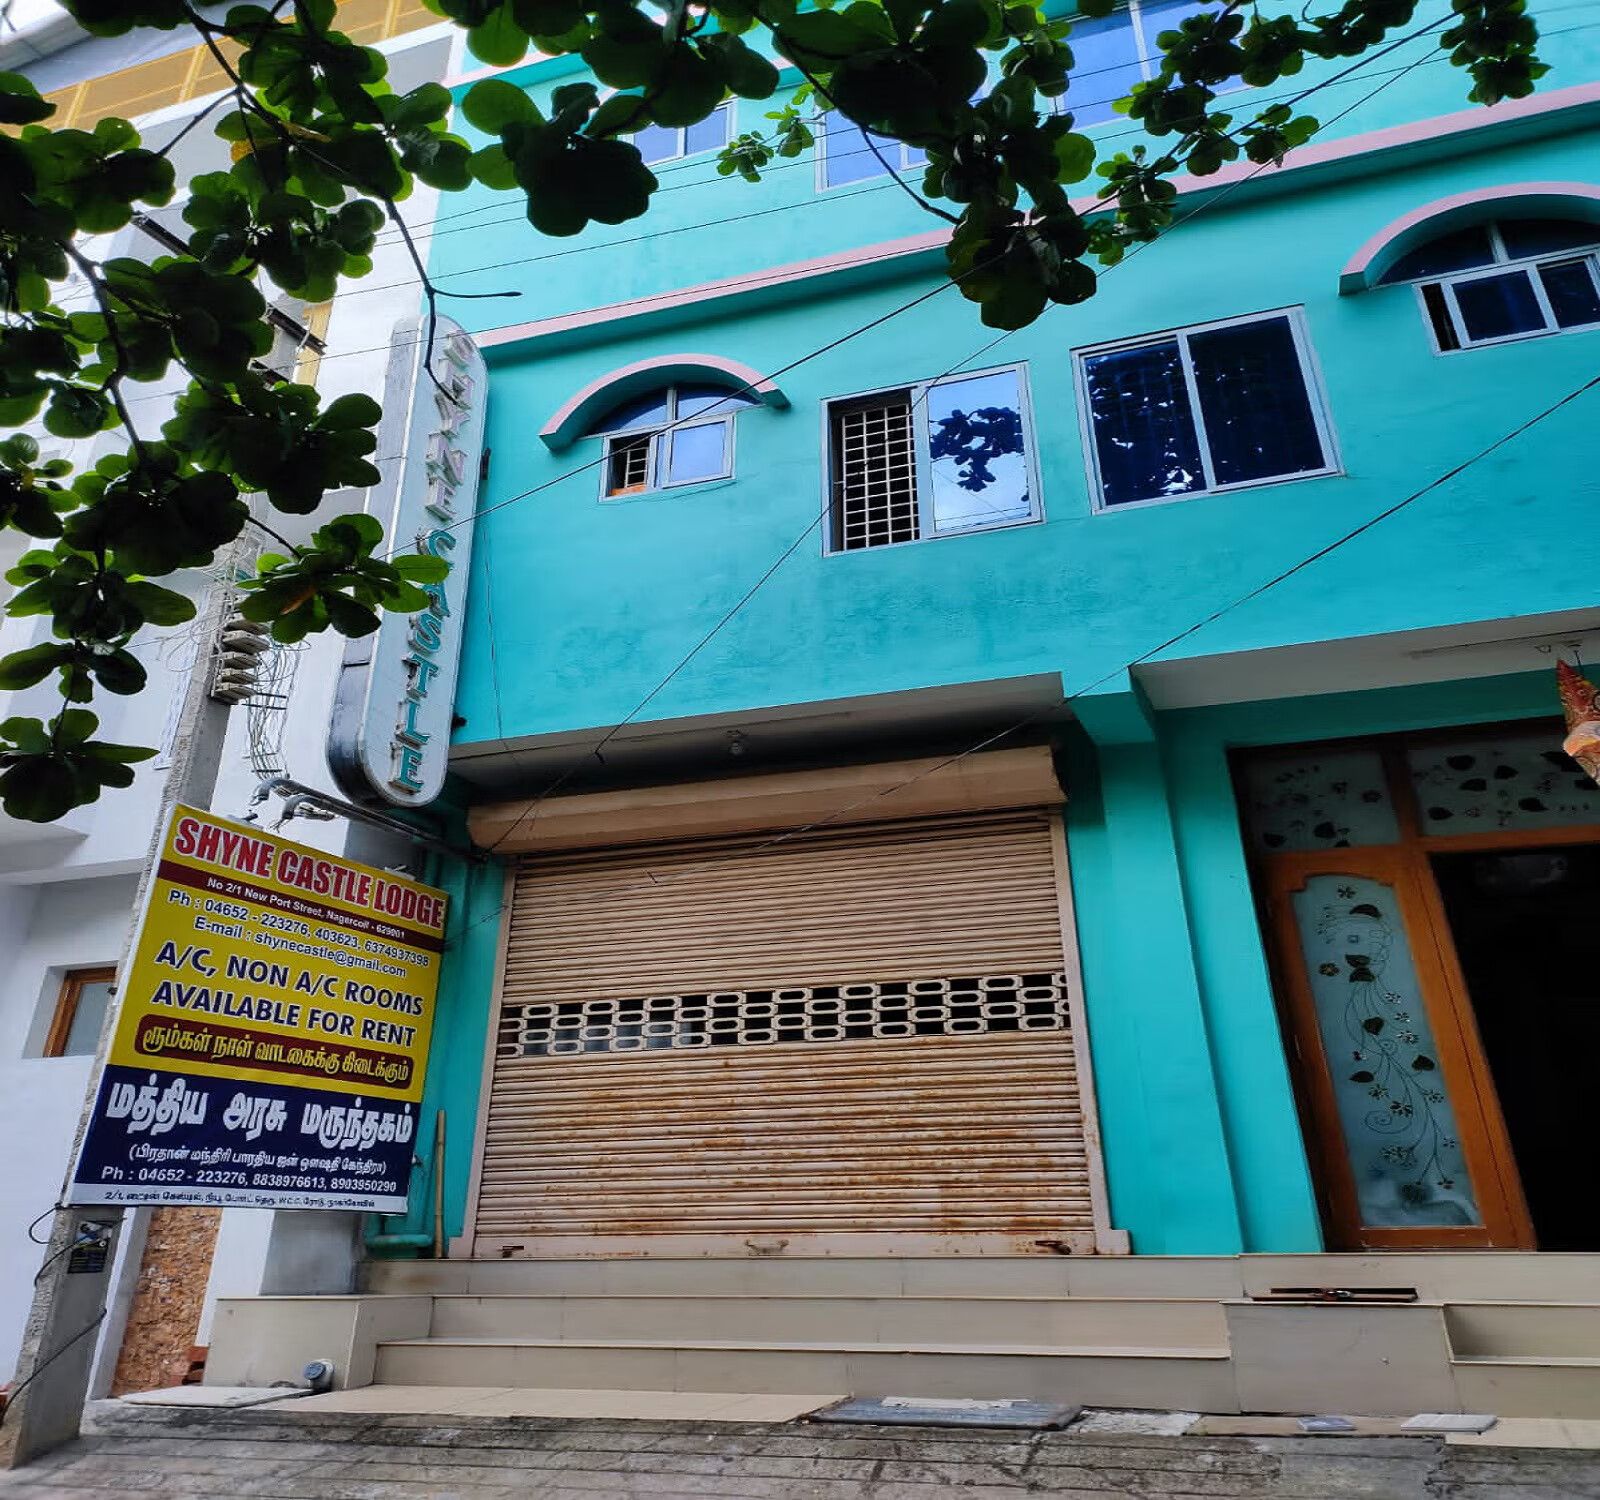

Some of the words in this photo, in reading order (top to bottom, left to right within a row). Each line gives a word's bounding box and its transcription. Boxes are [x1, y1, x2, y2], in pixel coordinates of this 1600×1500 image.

[174, 817, 276, 879] SHYNE
[277, 849, 374, 908] CASTLE
[373, 879, 446, 930] LODGE
[207, 876, 224, 889] No
[226, 883, 242, 896] 2/1
[245, 886, 268, 901] New
[269, 895, 291, 908] Port
[293, 901, 325, 919] Street,
[169, 889, 191, 906] Ph
[205, 898, 249, 921] 04652
[261, 912, 311, 937] 223276,
[194, 916, 242, 939] E-mail
[254, 932, 407, 977] shynecastle@gmail.com
[154, 939, 219, 978] A/C,
[226, 954, 290, 989] NON
[295, 970, 339, 998] A/C
[344, 979, 425, 1016] ROOMS
[151, 979, 301, 1027] AVAILABLE
[307, 1007, 356, 1037] FOR
[361, 1018, 417, 1048] RENT
[211, 1033, 255, 1060] நாள்
[255, 1041, 341, 1075] வாடகைக்கு
[341, 1050, 409, 1083] கிடைக்கும்
[105, 1072, 210, 1137] மத்திய
[223, 1092, 288, 1142] அரசு
[300, 1096, 413, 1152] மருந்தகம்
[100, 1166, 123, 1180] Ph
[138, 1168, 186, 1182] 04652
[196, 1169, 248, 1187] 223276,
